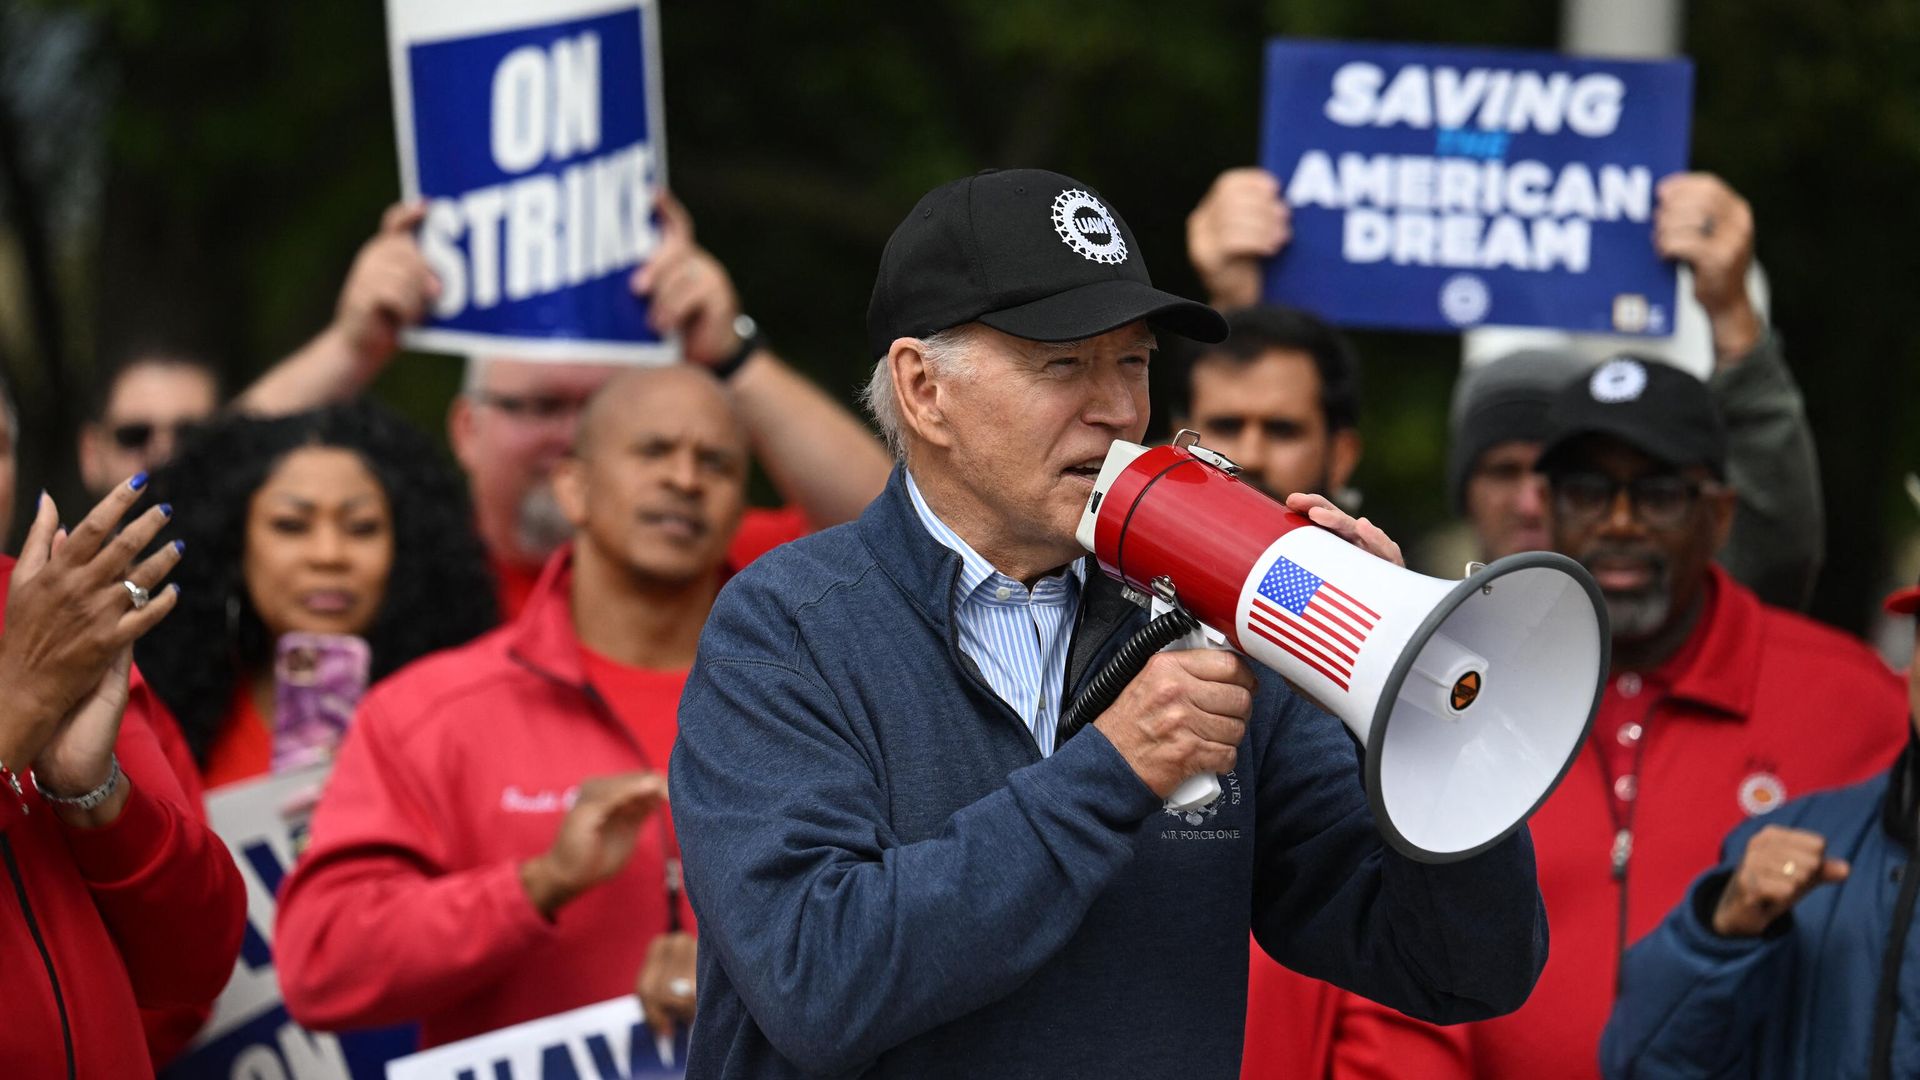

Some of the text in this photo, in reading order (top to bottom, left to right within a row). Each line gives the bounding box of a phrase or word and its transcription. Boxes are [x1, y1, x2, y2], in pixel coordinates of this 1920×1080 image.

[491, 31, 600, 174] ON
[1325, 62, 1624, 136] SAVING
[1288, 150, 1652, 222] AMERICAN
[422, 143, 660, 319] STRIKE
[1075, 217, 1109, 234] UAW
[1343, 208, 1592, 272] DREAM
[1226, 769, 1241, 805] TATES
[1160, 829, 1241, 840] AIR FORCE ONE
